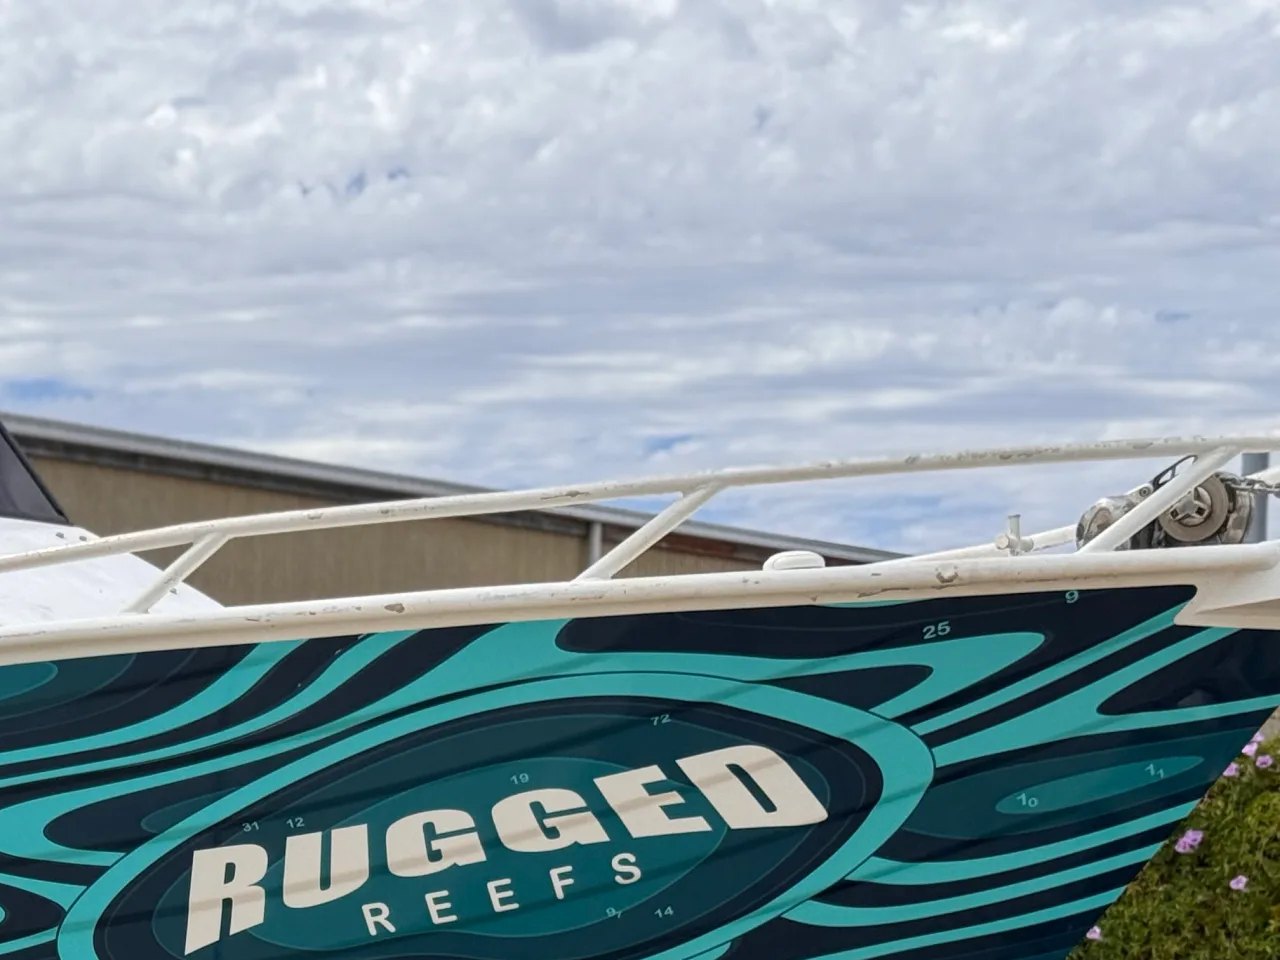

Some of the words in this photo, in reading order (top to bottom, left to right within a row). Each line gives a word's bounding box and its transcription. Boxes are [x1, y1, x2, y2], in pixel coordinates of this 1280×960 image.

[1064, 590, 1080, 604] 9
[922, 621, 951, 640] 25
[509, 772, 530, 786] 19
[242, 820, 261, 833] 31
[285, 816, 306, 830] 12
[184, 744, 829, 957] RUGGED
[360, 852, 643, 937] REEFS
[653, 905, 675, 919] 14
